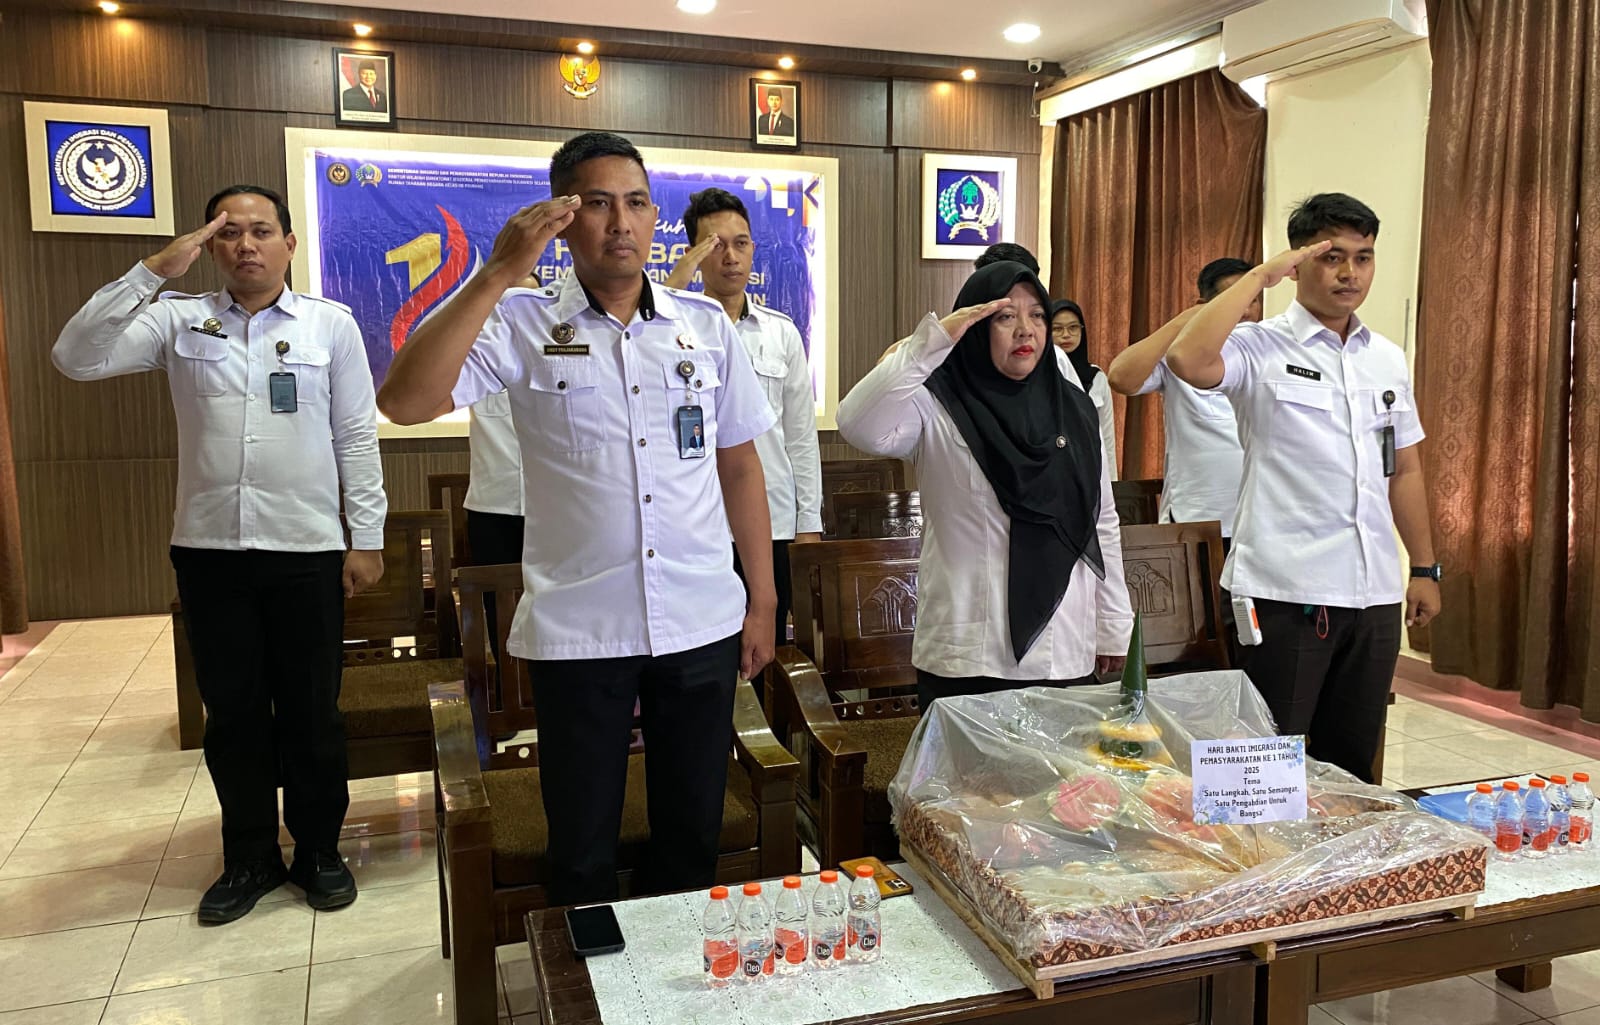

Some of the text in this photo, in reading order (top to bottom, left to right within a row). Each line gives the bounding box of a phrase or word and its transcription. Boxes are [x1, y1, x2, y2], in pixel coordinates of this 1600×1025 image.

[100, 129, 117, 138] DAN
[1293, 367, 1314, 377] HALIM
[1207, 742, 1291, 754] HARI BAKTI IMIGRASI DAN
[1200, 751, 1298, 765] PEMASYARAKATAN KE 1 TAHUN
[1244, 766, 1260, 774] 2025
[1243, 777, 1261, 785] Tema
[1252, 787, 1267, 795] Satu
[1214, 795, 1287, 809] Satu Pengabdian Untuk
[746, 962, 760, 972] Cleo
